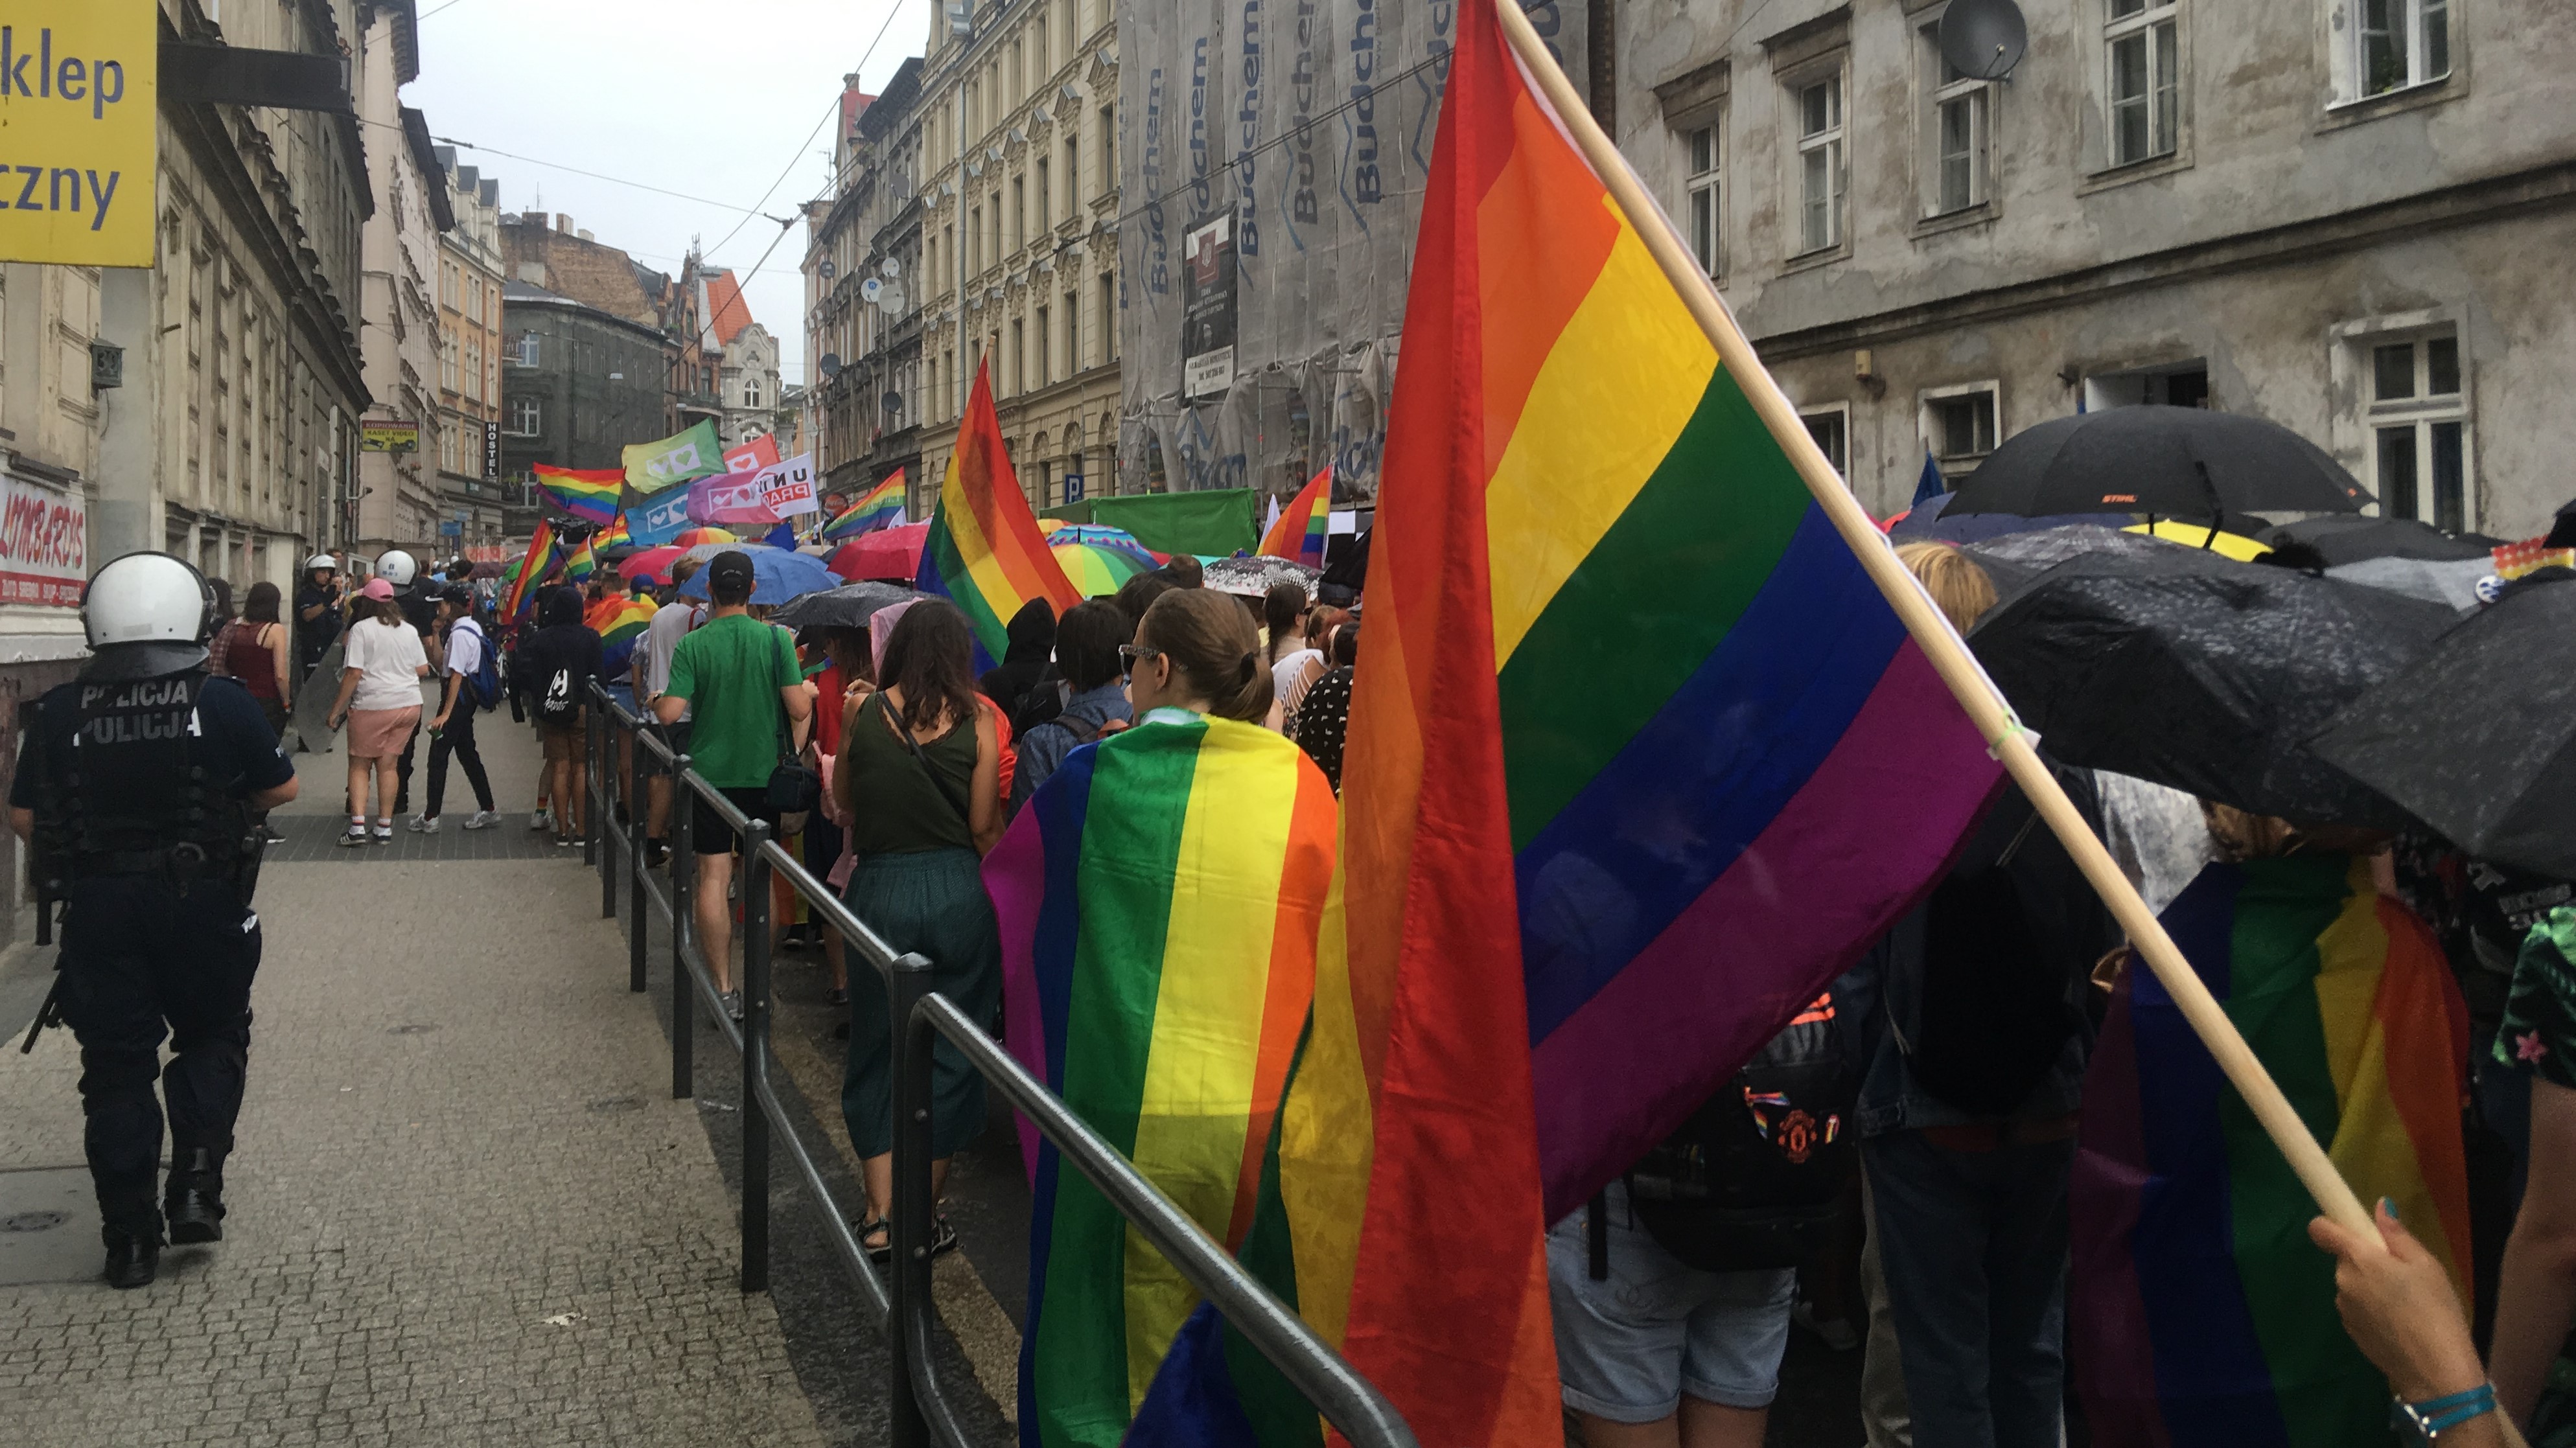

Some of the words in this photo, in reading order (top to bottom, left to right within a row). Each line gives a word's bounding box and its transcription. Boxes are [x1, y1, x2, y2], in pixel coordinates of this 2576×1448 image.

[1143, 68, 1170, 295] Budchem
[1190, 37, 1209, 219] dchem
[1238, 1, 1259, 257] Budchem
[1291, 0, 1318, 225] Budche
[488, 423, 496, 476] HOSTEL
[1069, 477, 1080, 503] P
[2102, 494, 2138, 503] STIHL
